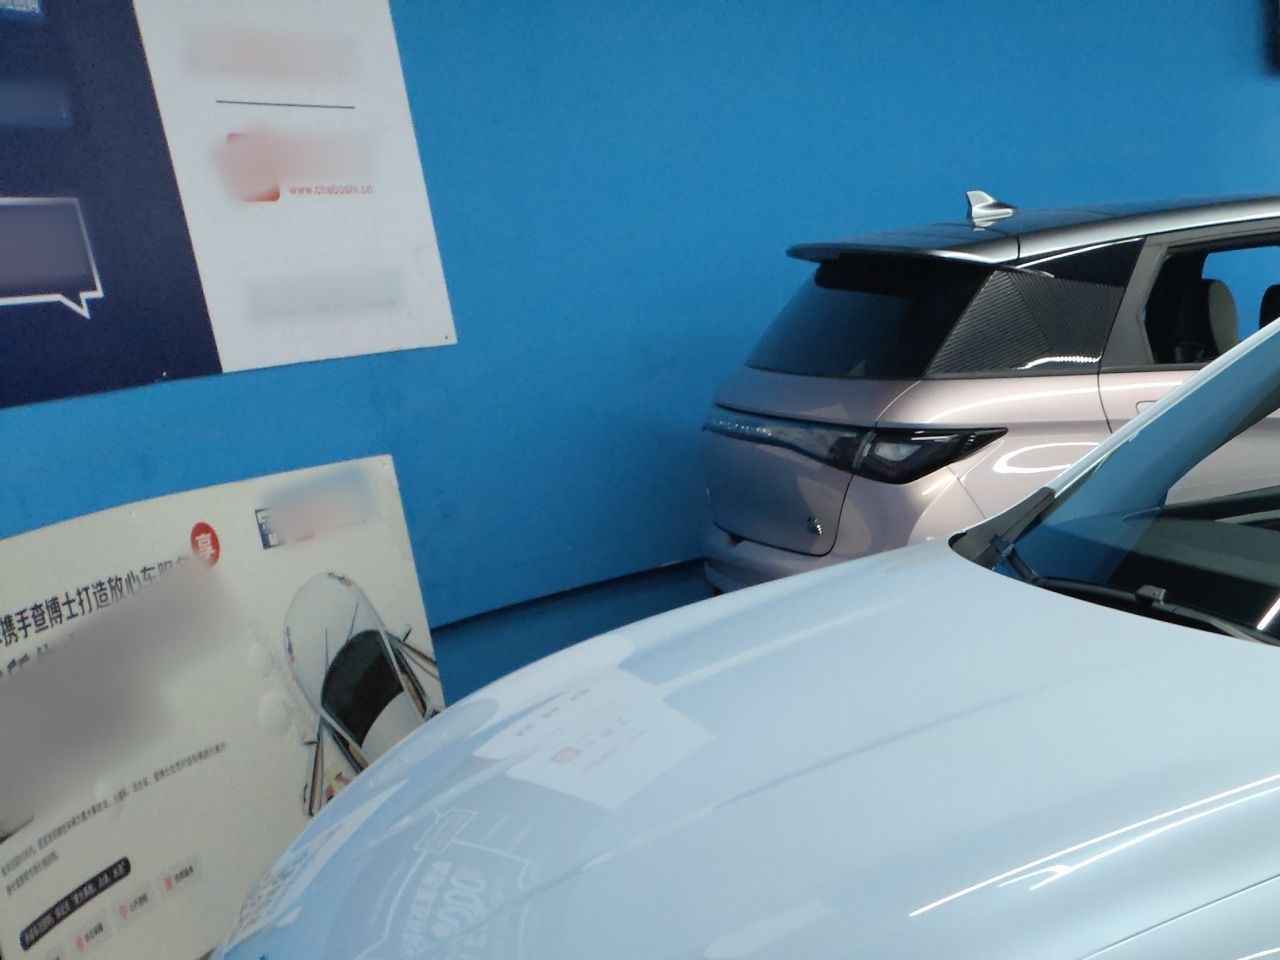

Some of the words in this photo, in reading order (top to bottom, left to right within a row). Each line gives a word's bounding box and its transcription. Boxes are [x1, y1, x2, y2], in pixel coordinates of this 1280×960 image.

[289, 183, 373, 196] www.chaboshi.cn
[0, 556, 190, 648] 携手查博士打造放心车服
